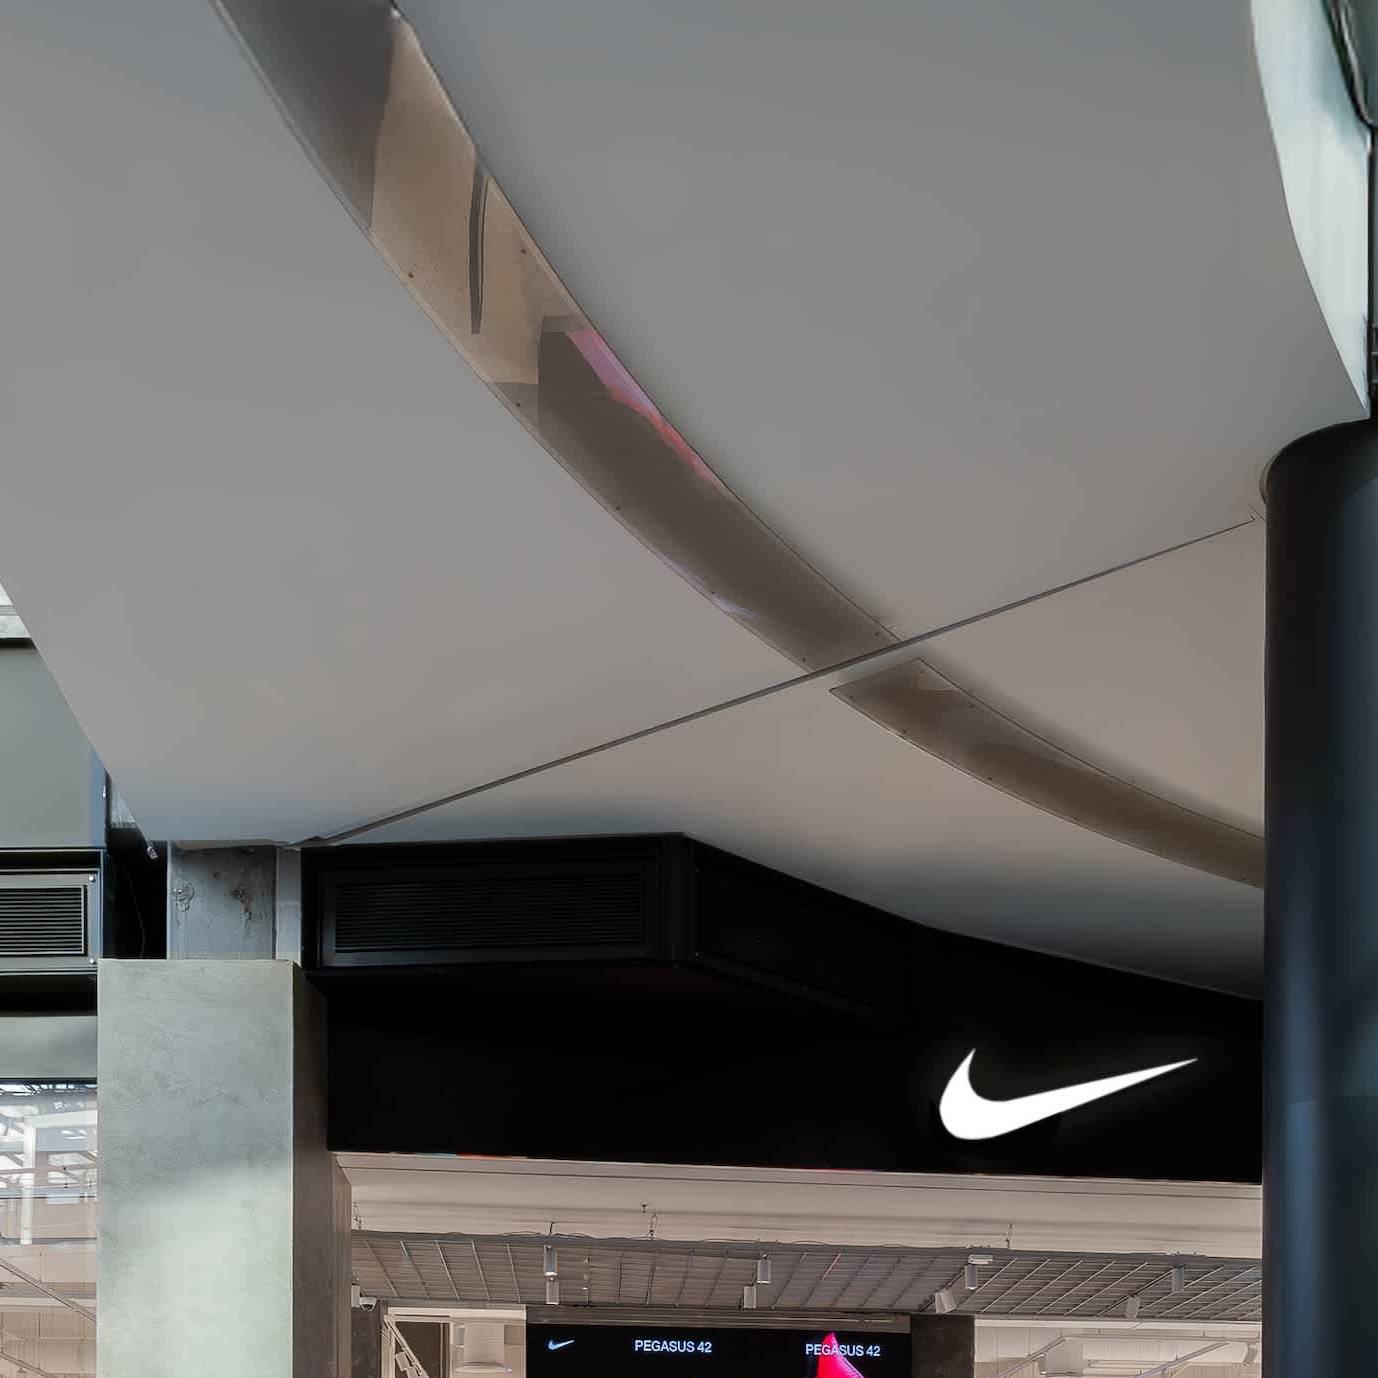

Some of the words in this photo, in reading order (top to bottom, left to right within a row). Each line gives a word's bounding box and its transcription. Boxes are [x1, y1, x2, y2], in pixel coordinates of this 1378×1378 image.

[634, 1339, 695, 1353] PEGASUS
[696, 1341, 713, 1353] 42
[805, 1343, 864, 1356] PEGASUS
[865, 1345, 881, 1357] 42
